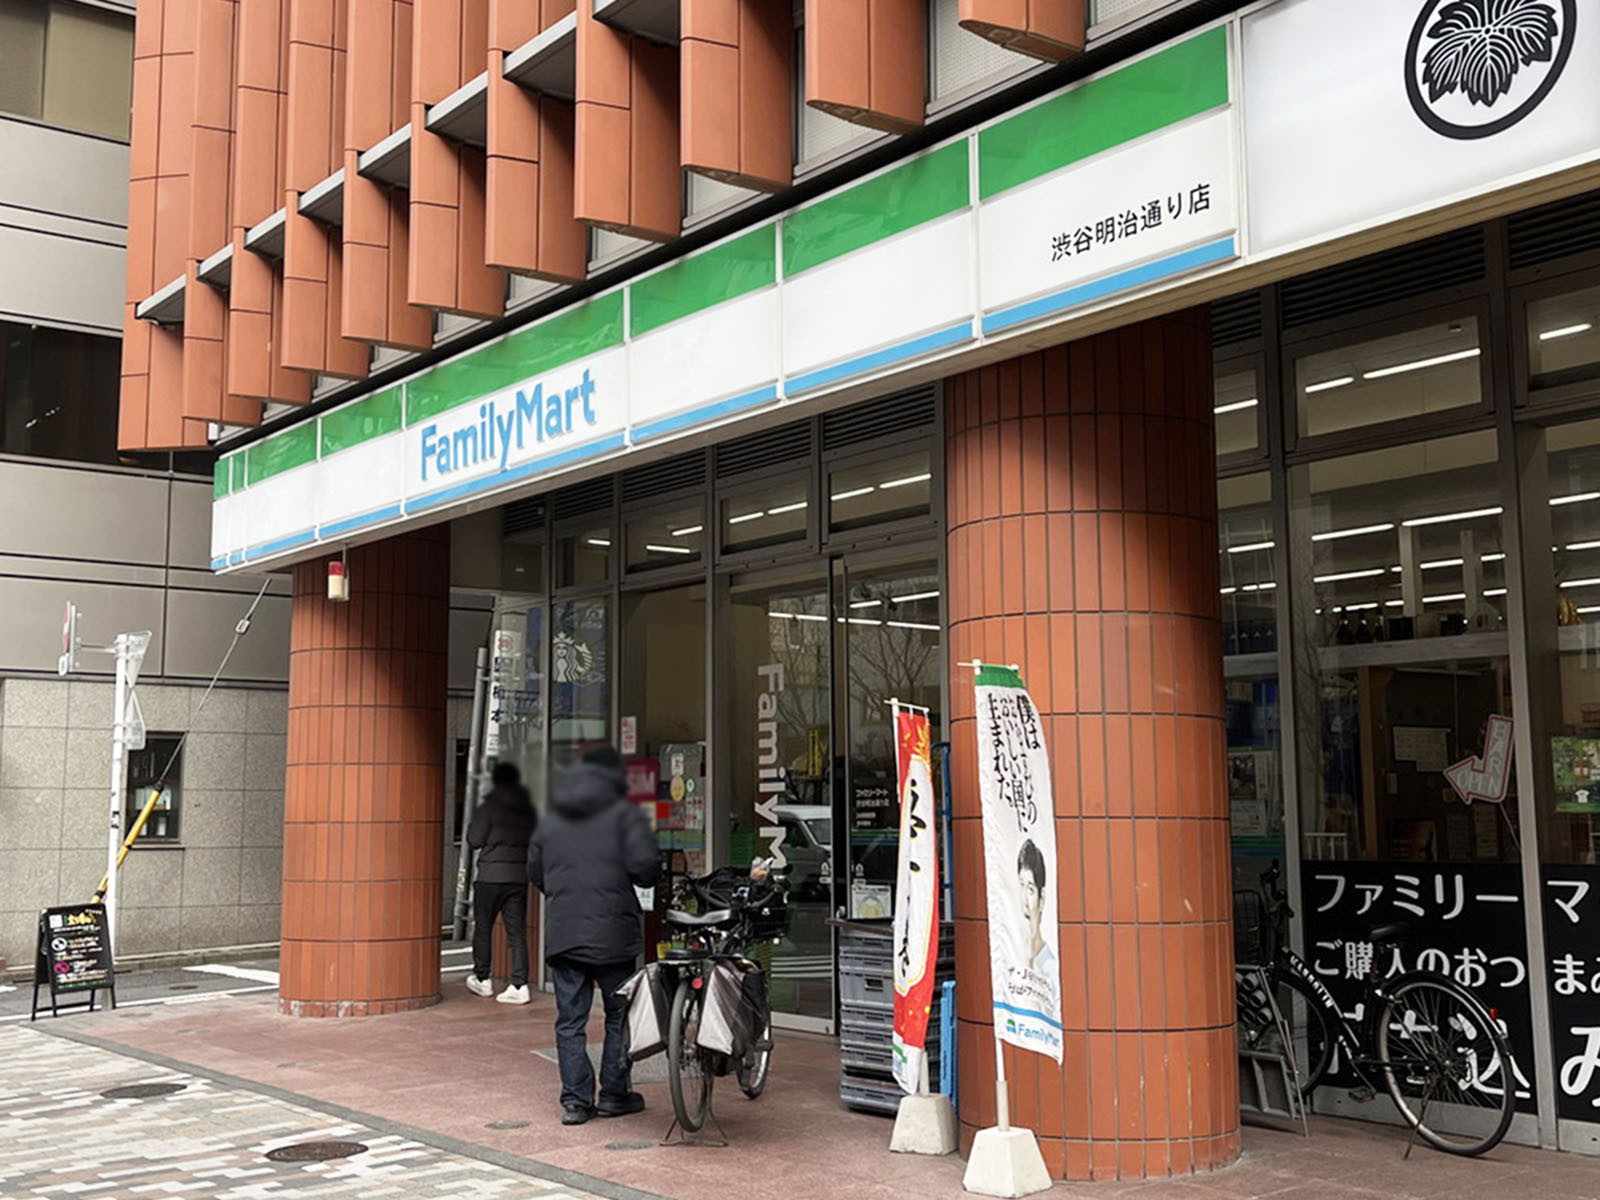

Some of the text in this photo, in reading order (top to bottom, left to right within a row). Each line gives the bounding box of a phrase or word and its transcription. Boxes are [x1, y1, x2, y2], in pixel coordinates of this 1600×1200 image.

[1051, 183, 1211, 262] 渋谷明治通り店
[421, 367, 597, 482] FamilyMart
[1456, 769, 1502, 797] OPEN
